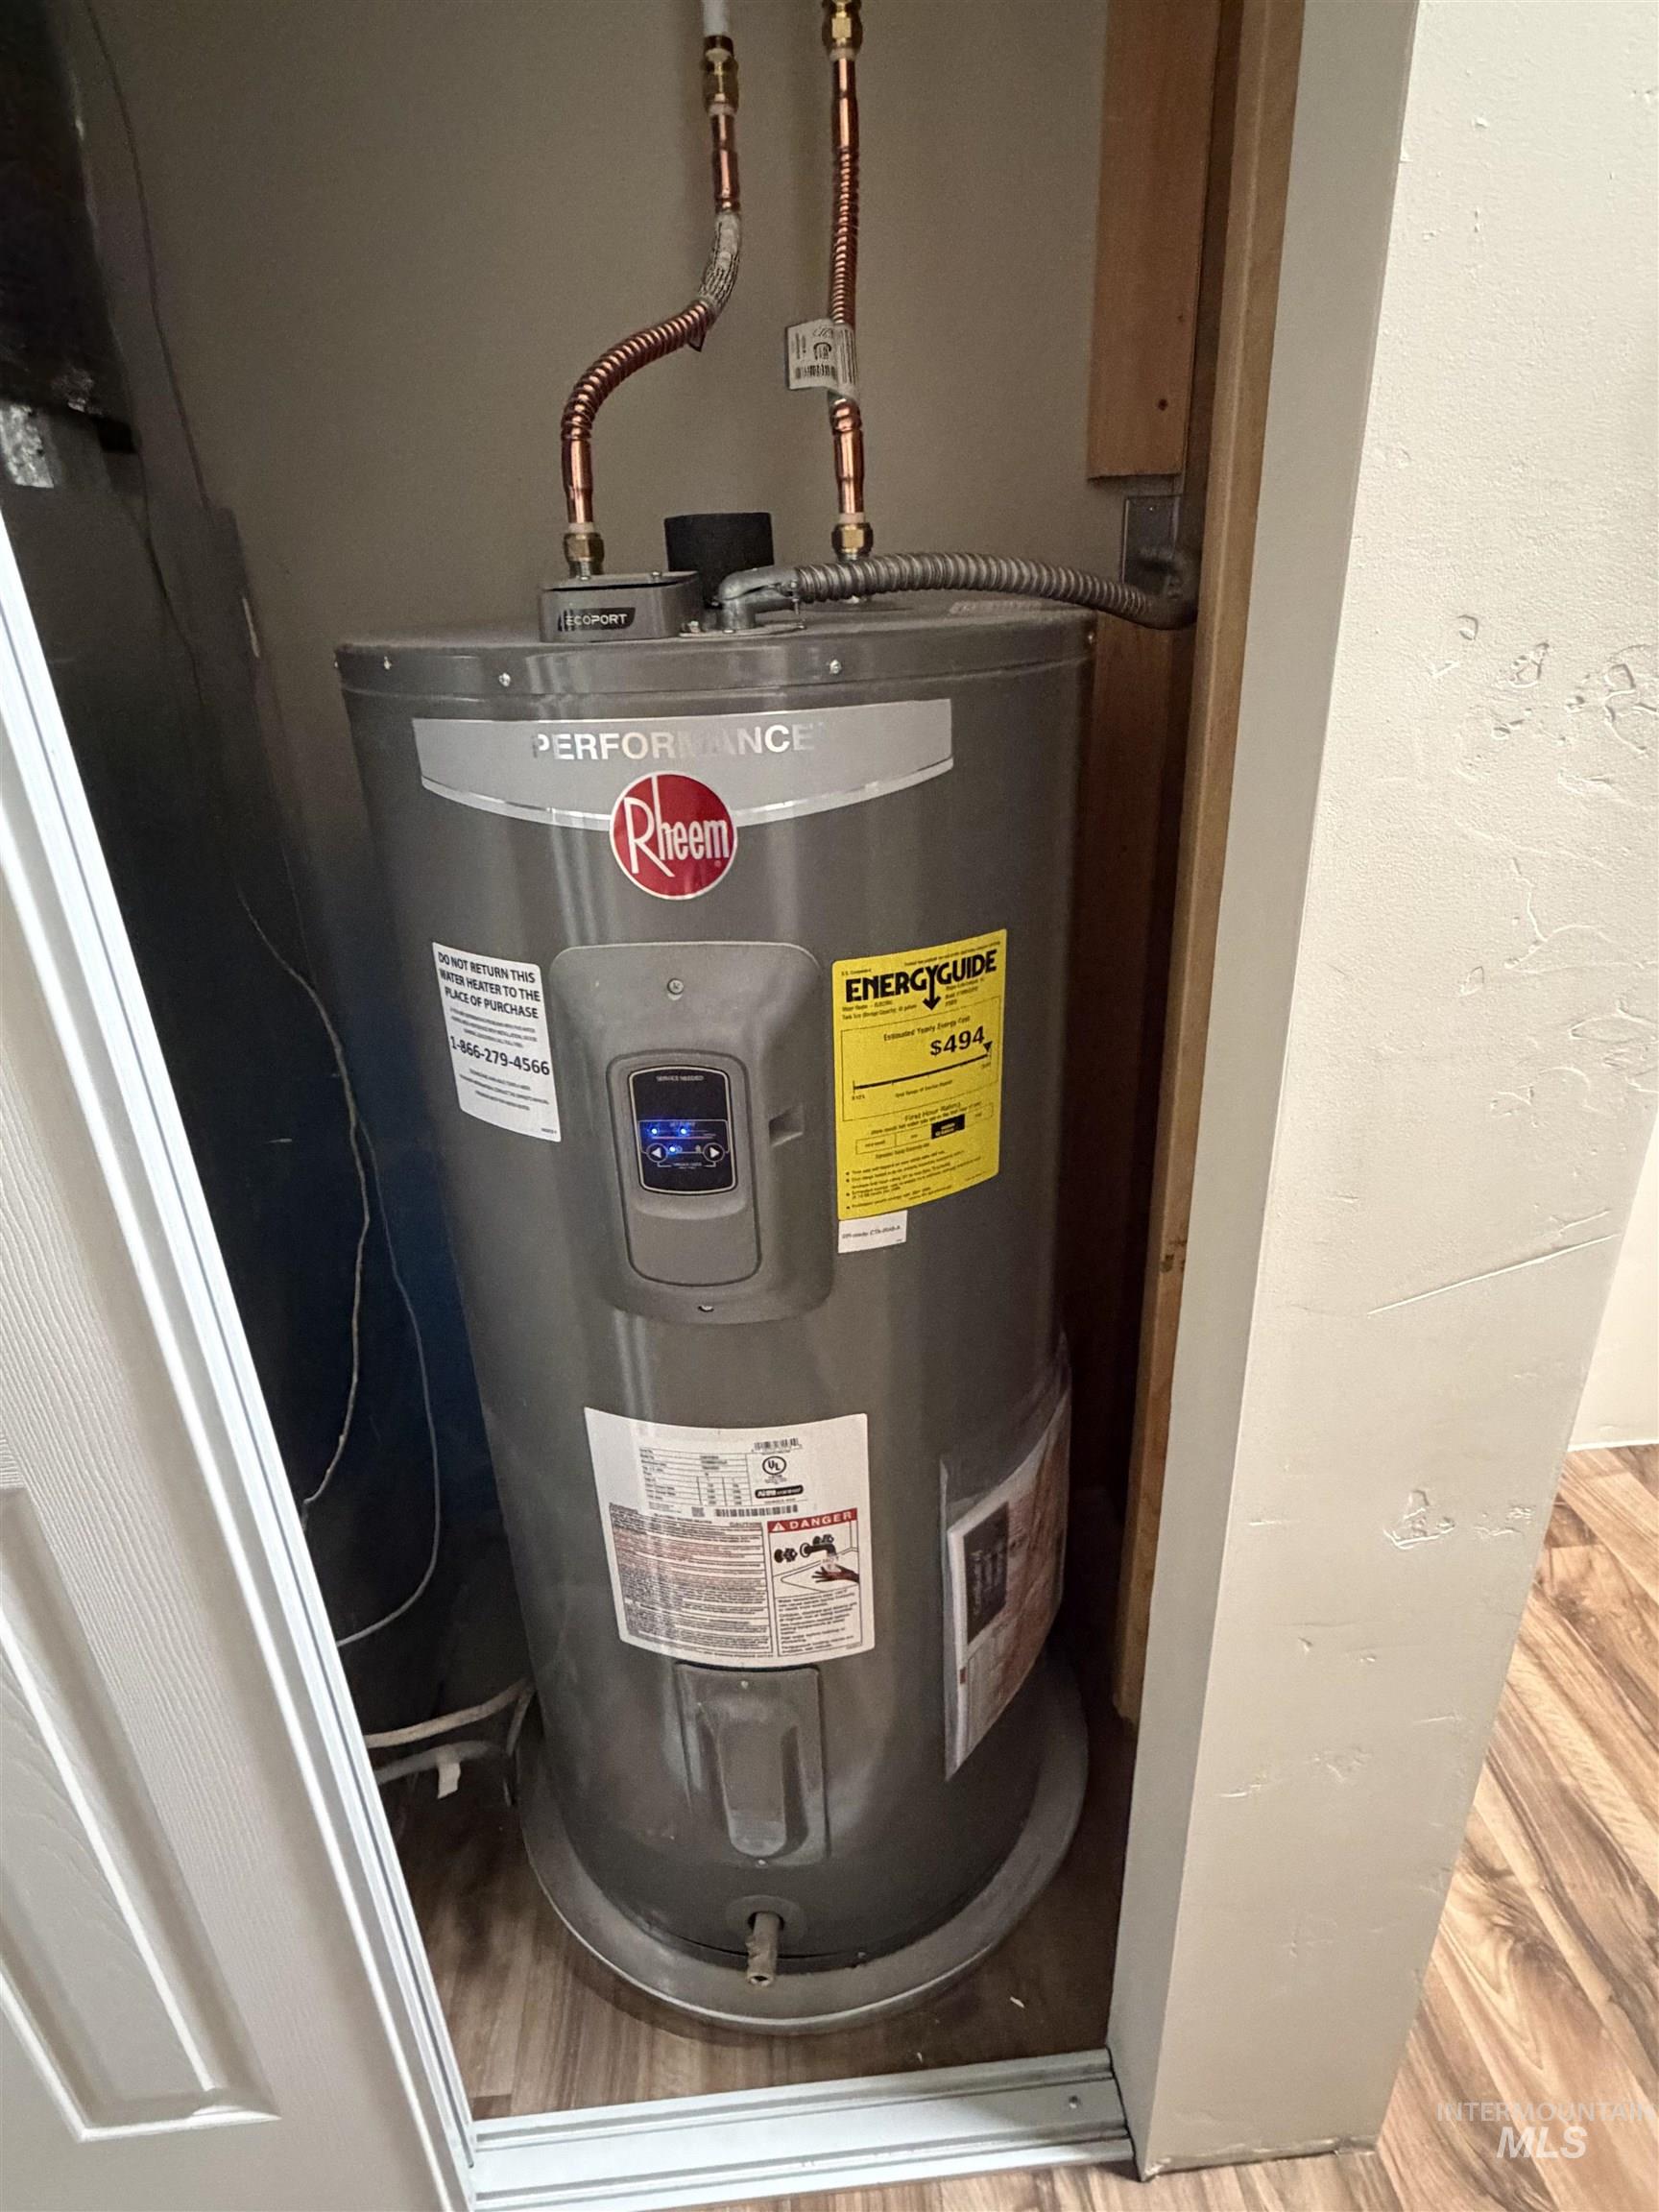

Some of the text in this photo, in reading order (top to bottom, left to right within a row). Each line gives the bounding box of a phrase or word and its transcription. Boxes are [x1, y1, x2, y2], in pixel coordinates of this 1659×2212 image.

[565, 613, 627, 626] ECOPORT
[624, 775, 731, 878] Rheem
[438, 951, 536, 983] DO NOT RETURN THIS
[439, 969, 541, 1001] WATER HEATER TO THE
[445, 986, 540, 1019] PLACE OF PURCHASE
[450, 1035, 550, 1076] 1-866-279-4566
[930, 1024, 985, 1057] $494
[768, 1460, 781, 1471] UL
[789, 1511, 853, 1529] DANGER
